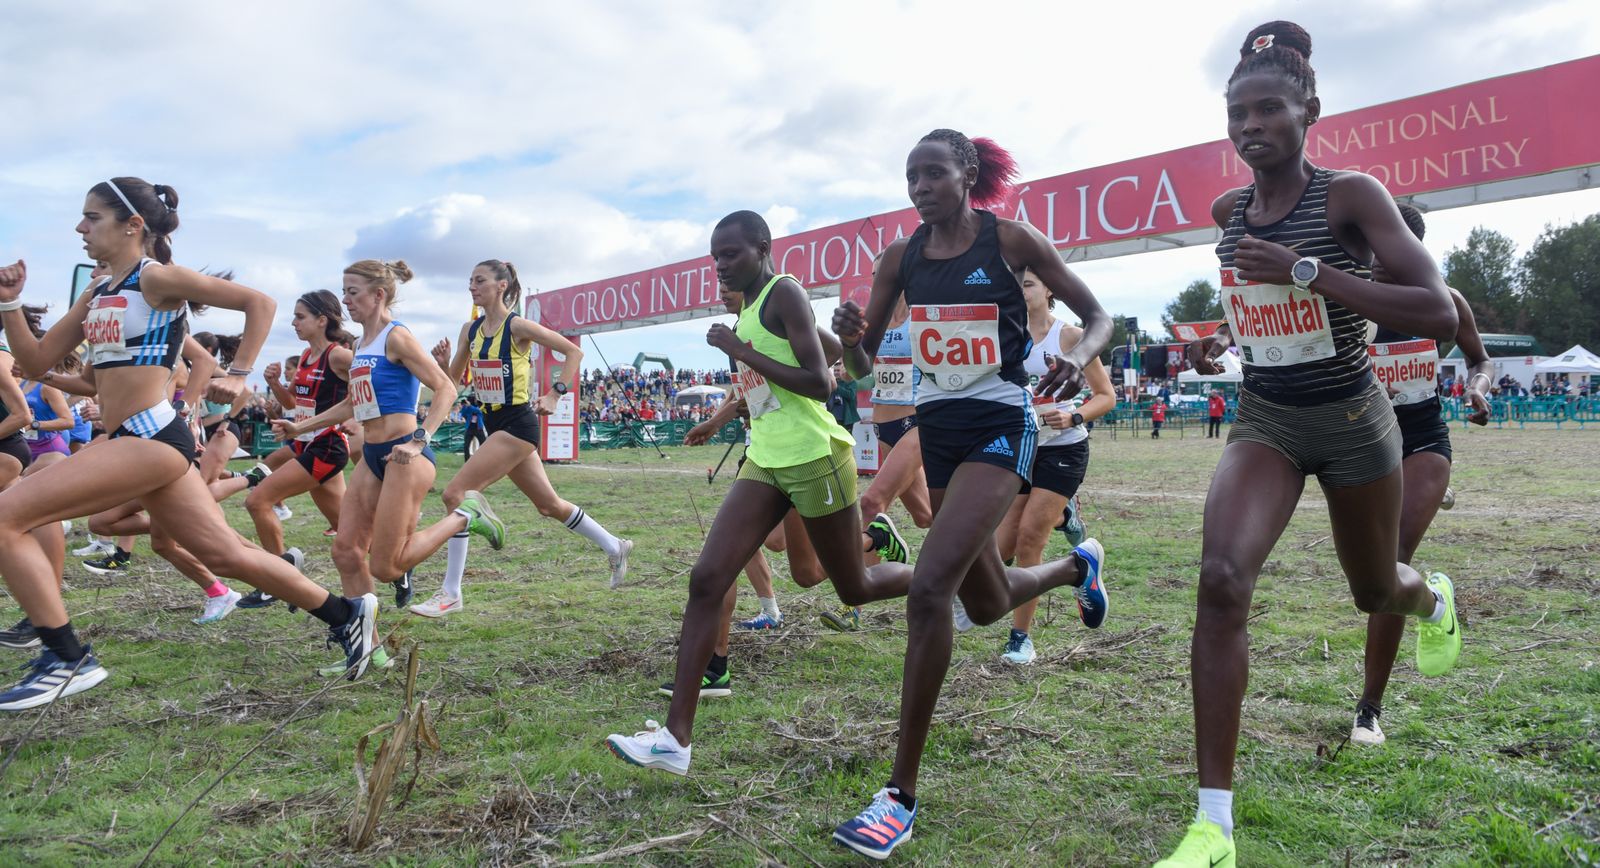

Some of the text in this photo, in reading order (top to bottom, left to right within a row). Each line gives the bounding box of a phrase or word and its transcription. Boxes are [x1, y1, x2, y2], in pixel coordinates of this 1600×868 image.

[1344, 137, 1531, 190] OUNTRY
[964, 277, 992, 285] adidas
[572, 282, 641, 325] CROSS
[1230, 289, 1324, 337] Chemutai
[919, 328, 996, 366] Can
[877, 371, 905, 384] 1602
[983, 446, 1014, 457] adidas
